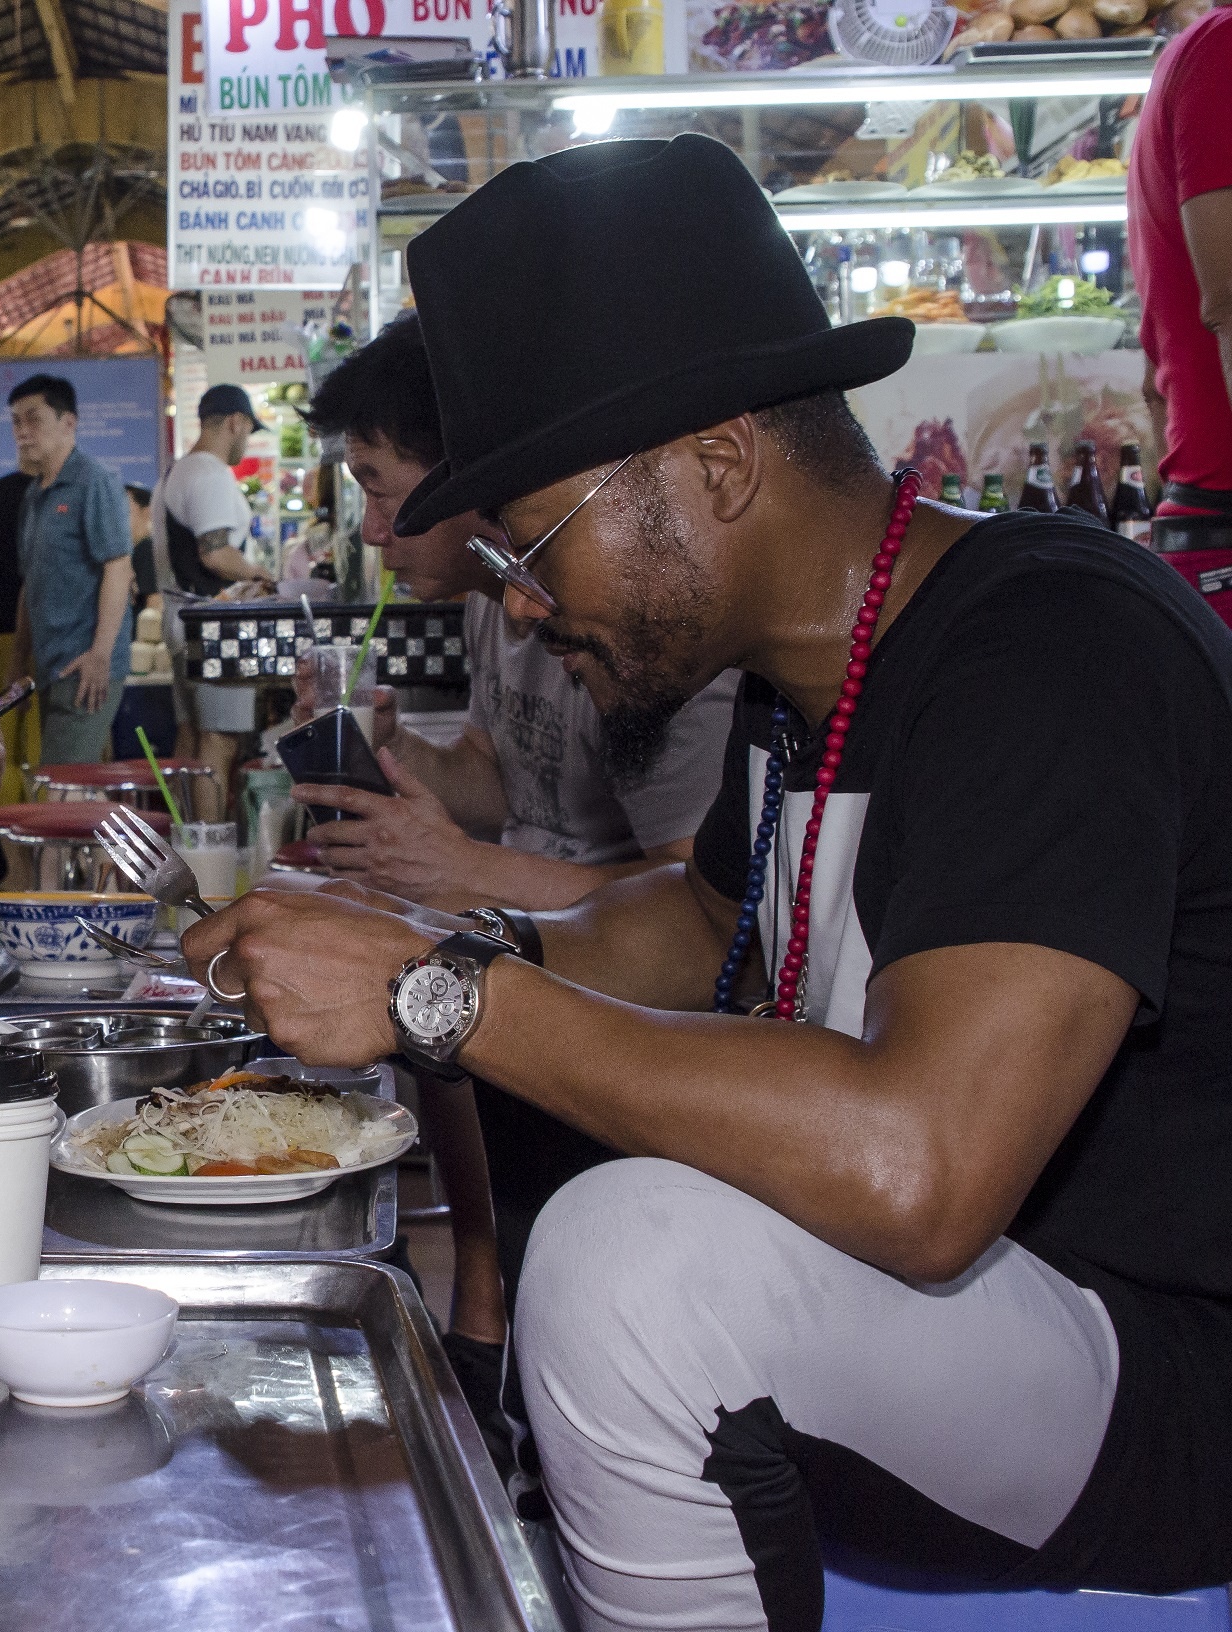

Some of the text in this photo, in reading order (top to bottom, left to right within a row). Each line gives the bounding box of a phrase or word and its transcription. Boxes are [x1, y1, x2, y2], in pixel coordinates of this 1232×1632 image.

[220, 65, 269, 109] BÚN
[277, 63, 331, 108] TÔM
[236, 211, 285, 231] CANH
[239, 353, 306, 373] HALAL
